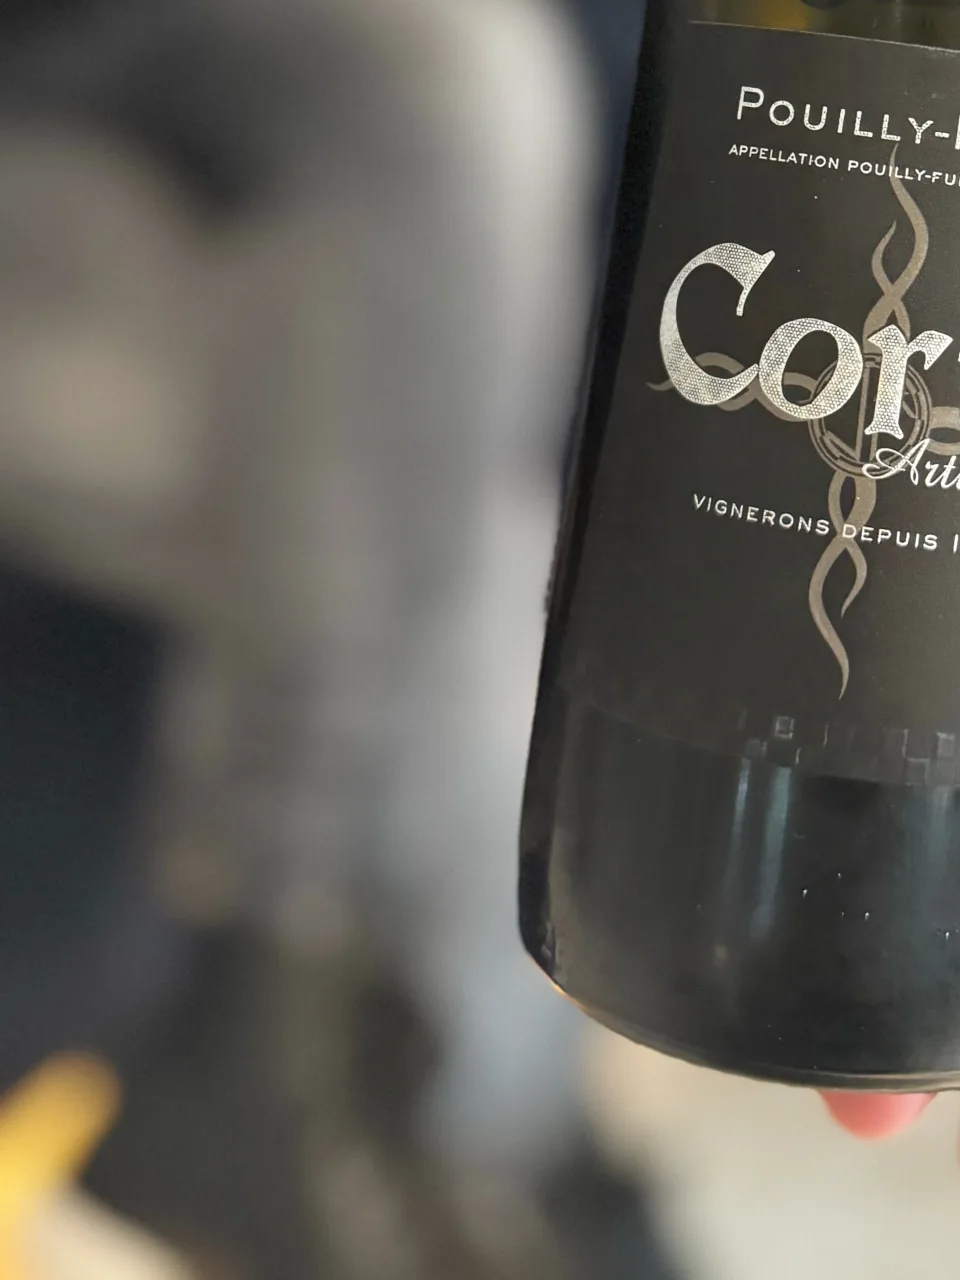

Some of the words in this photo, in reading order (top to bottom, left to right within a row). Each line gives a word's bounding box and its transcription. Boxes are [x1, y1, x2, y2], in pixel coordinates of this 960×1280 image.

[728, 144, 840, 170] APPELLATION
[692, 493, 831, 536] VIGNERONS
[841, 523, 939, 552] DEPUIS
